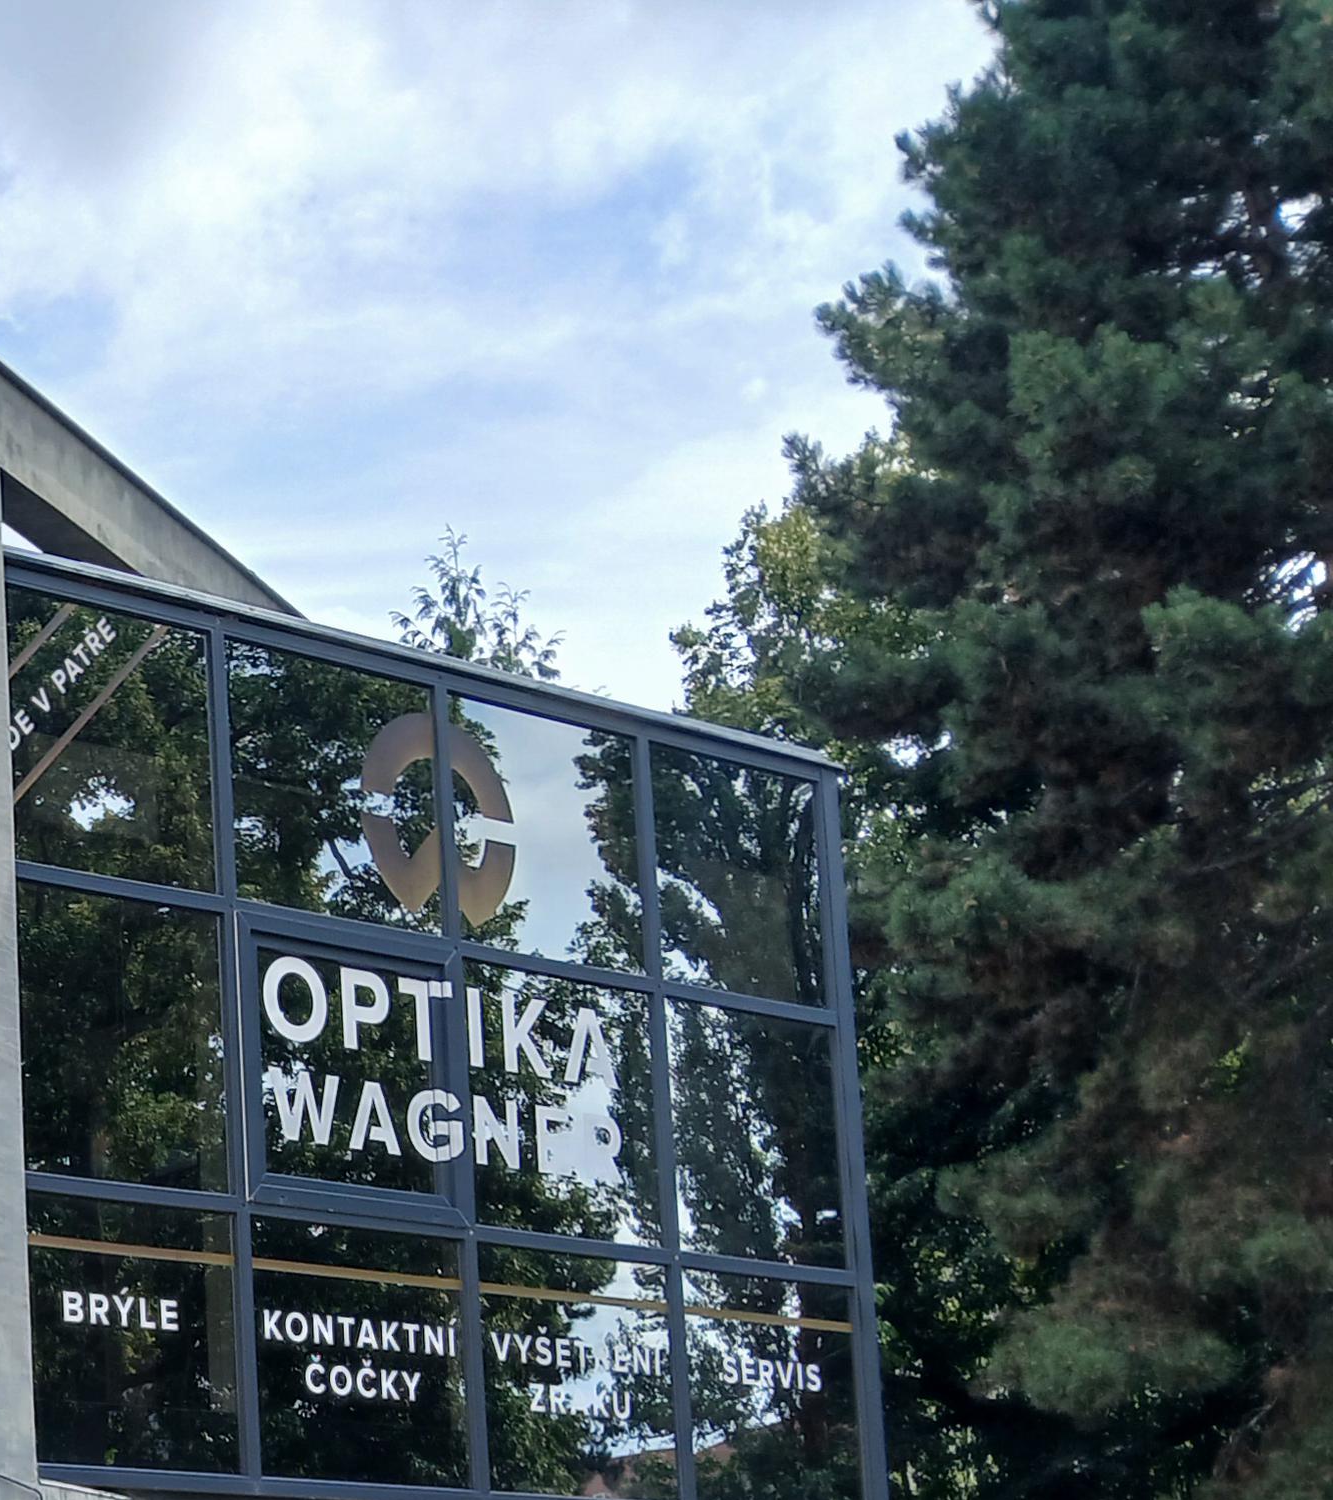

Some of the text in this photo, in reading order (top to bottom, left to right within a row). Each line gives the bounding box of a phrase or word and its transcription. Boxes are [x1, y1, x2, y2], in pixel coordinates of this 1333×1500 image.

[30, 687, 51, 713] V
[51, 616, 117, 694] PATŘE
[262, 956, 620, 1090] OPTIKA
[267, 1065, 623, 1184] WAGNER
[61, 1287, 180, 1332] BRÝLE
[263, 1308, 456, 1358] KONTAKTNÍ
[304, 1351, 422, 1402] ČOČKY
[722, 1357, 823, 1393] SERVIS
